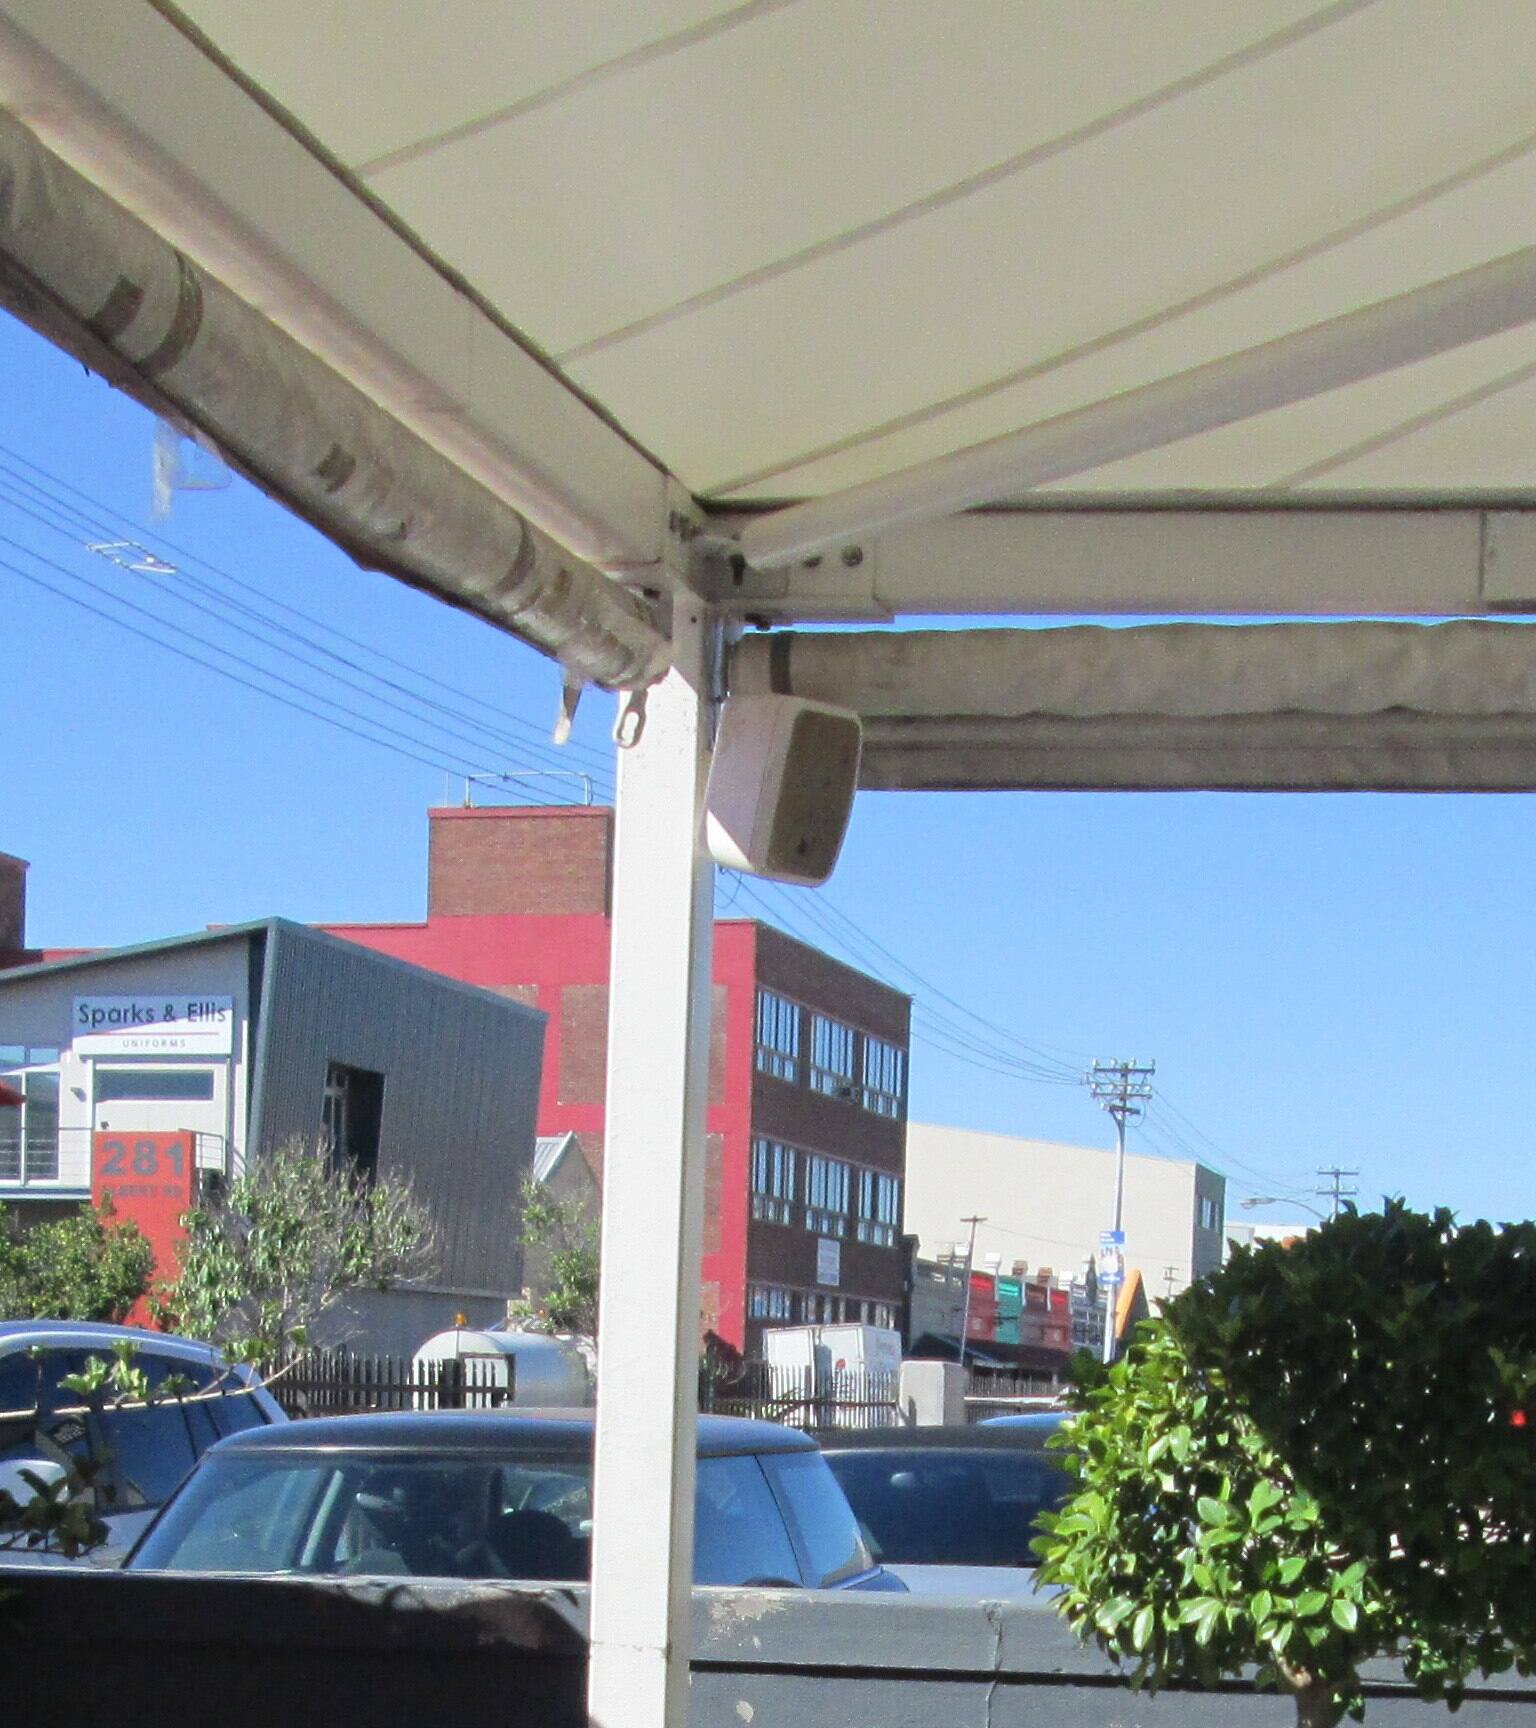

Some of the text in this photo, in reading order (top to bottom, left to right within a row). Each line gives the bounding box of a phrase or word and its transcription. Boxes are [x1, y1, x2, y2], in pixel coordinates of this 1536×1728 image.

[79, 1002, 226, 1027] Sparks & Ellis
[122, 1039, 186, 1048] UNIFORMS
[101, 1140, 184, 1177] 281
